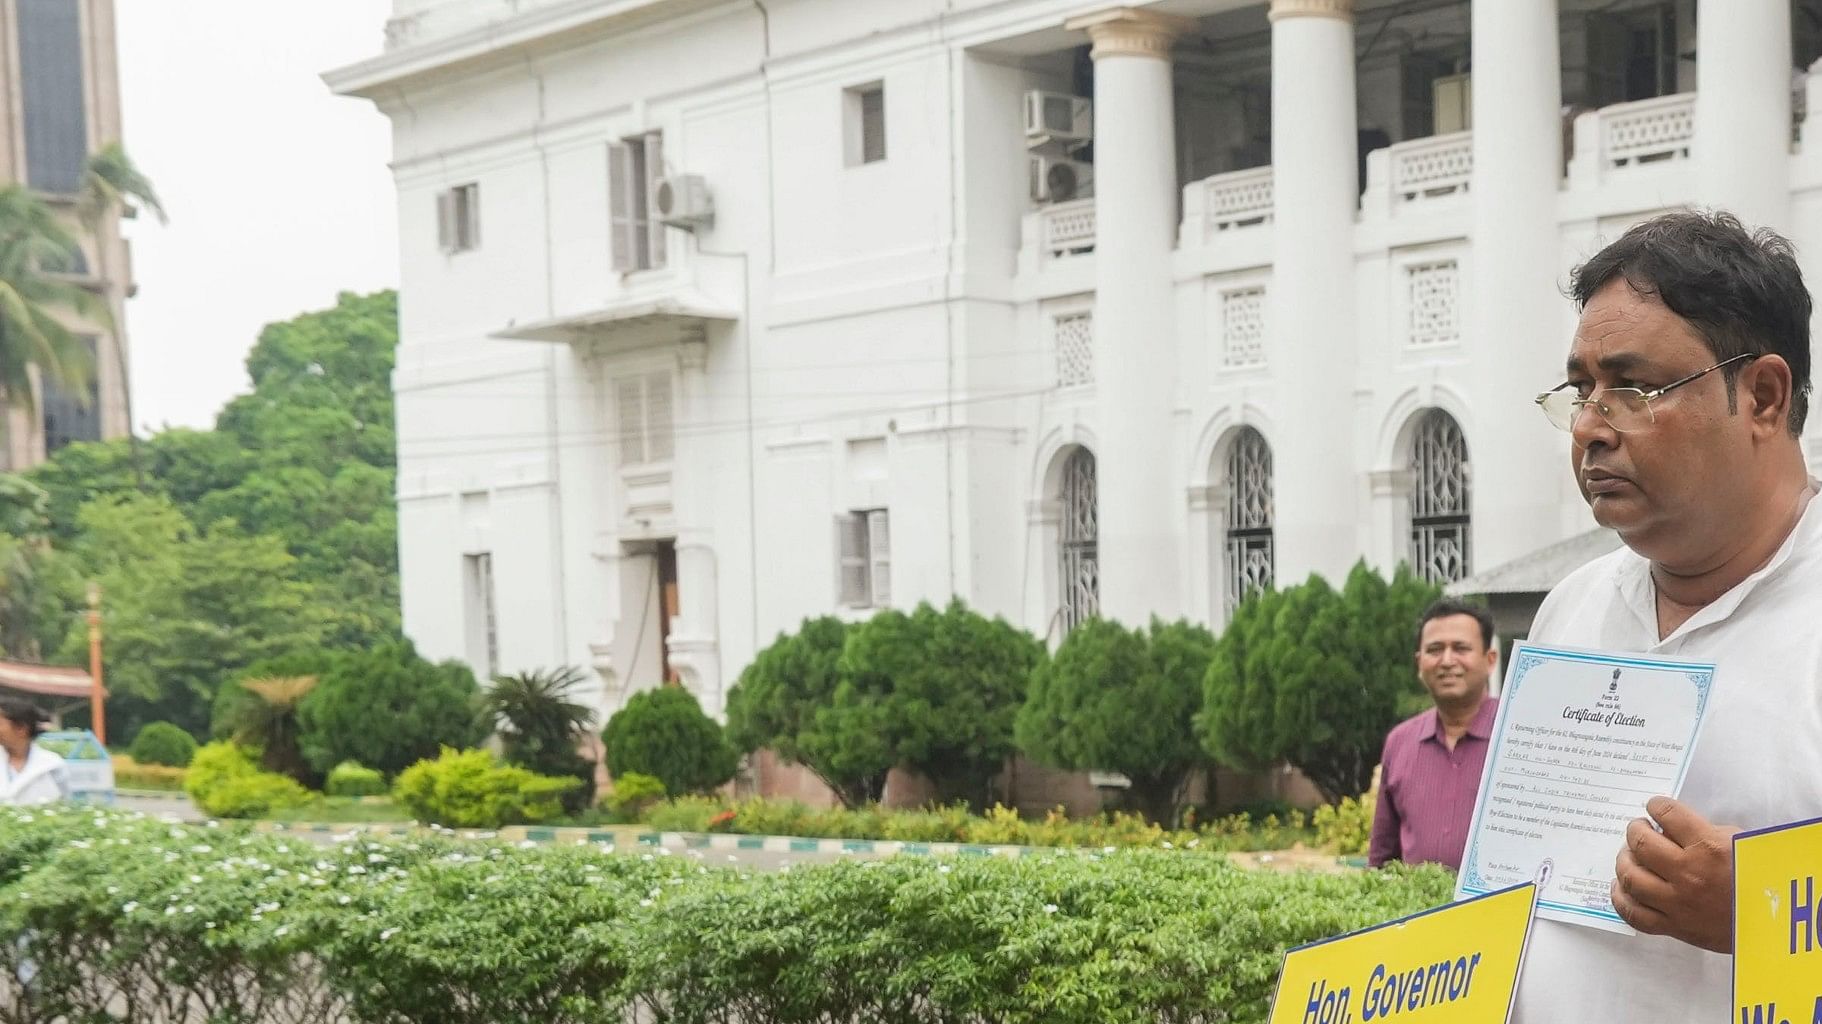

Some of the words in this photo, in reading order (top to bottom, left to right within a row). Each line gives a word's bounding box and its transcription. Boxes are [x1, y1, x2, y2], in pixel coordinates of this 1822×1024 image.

[1562, 706, 1605, 724] Certificate
[1604, 711, 1616, 728] of
[1614, 712, 1646, 728] Election
[1362, 951, 1482, 1022] Governor
